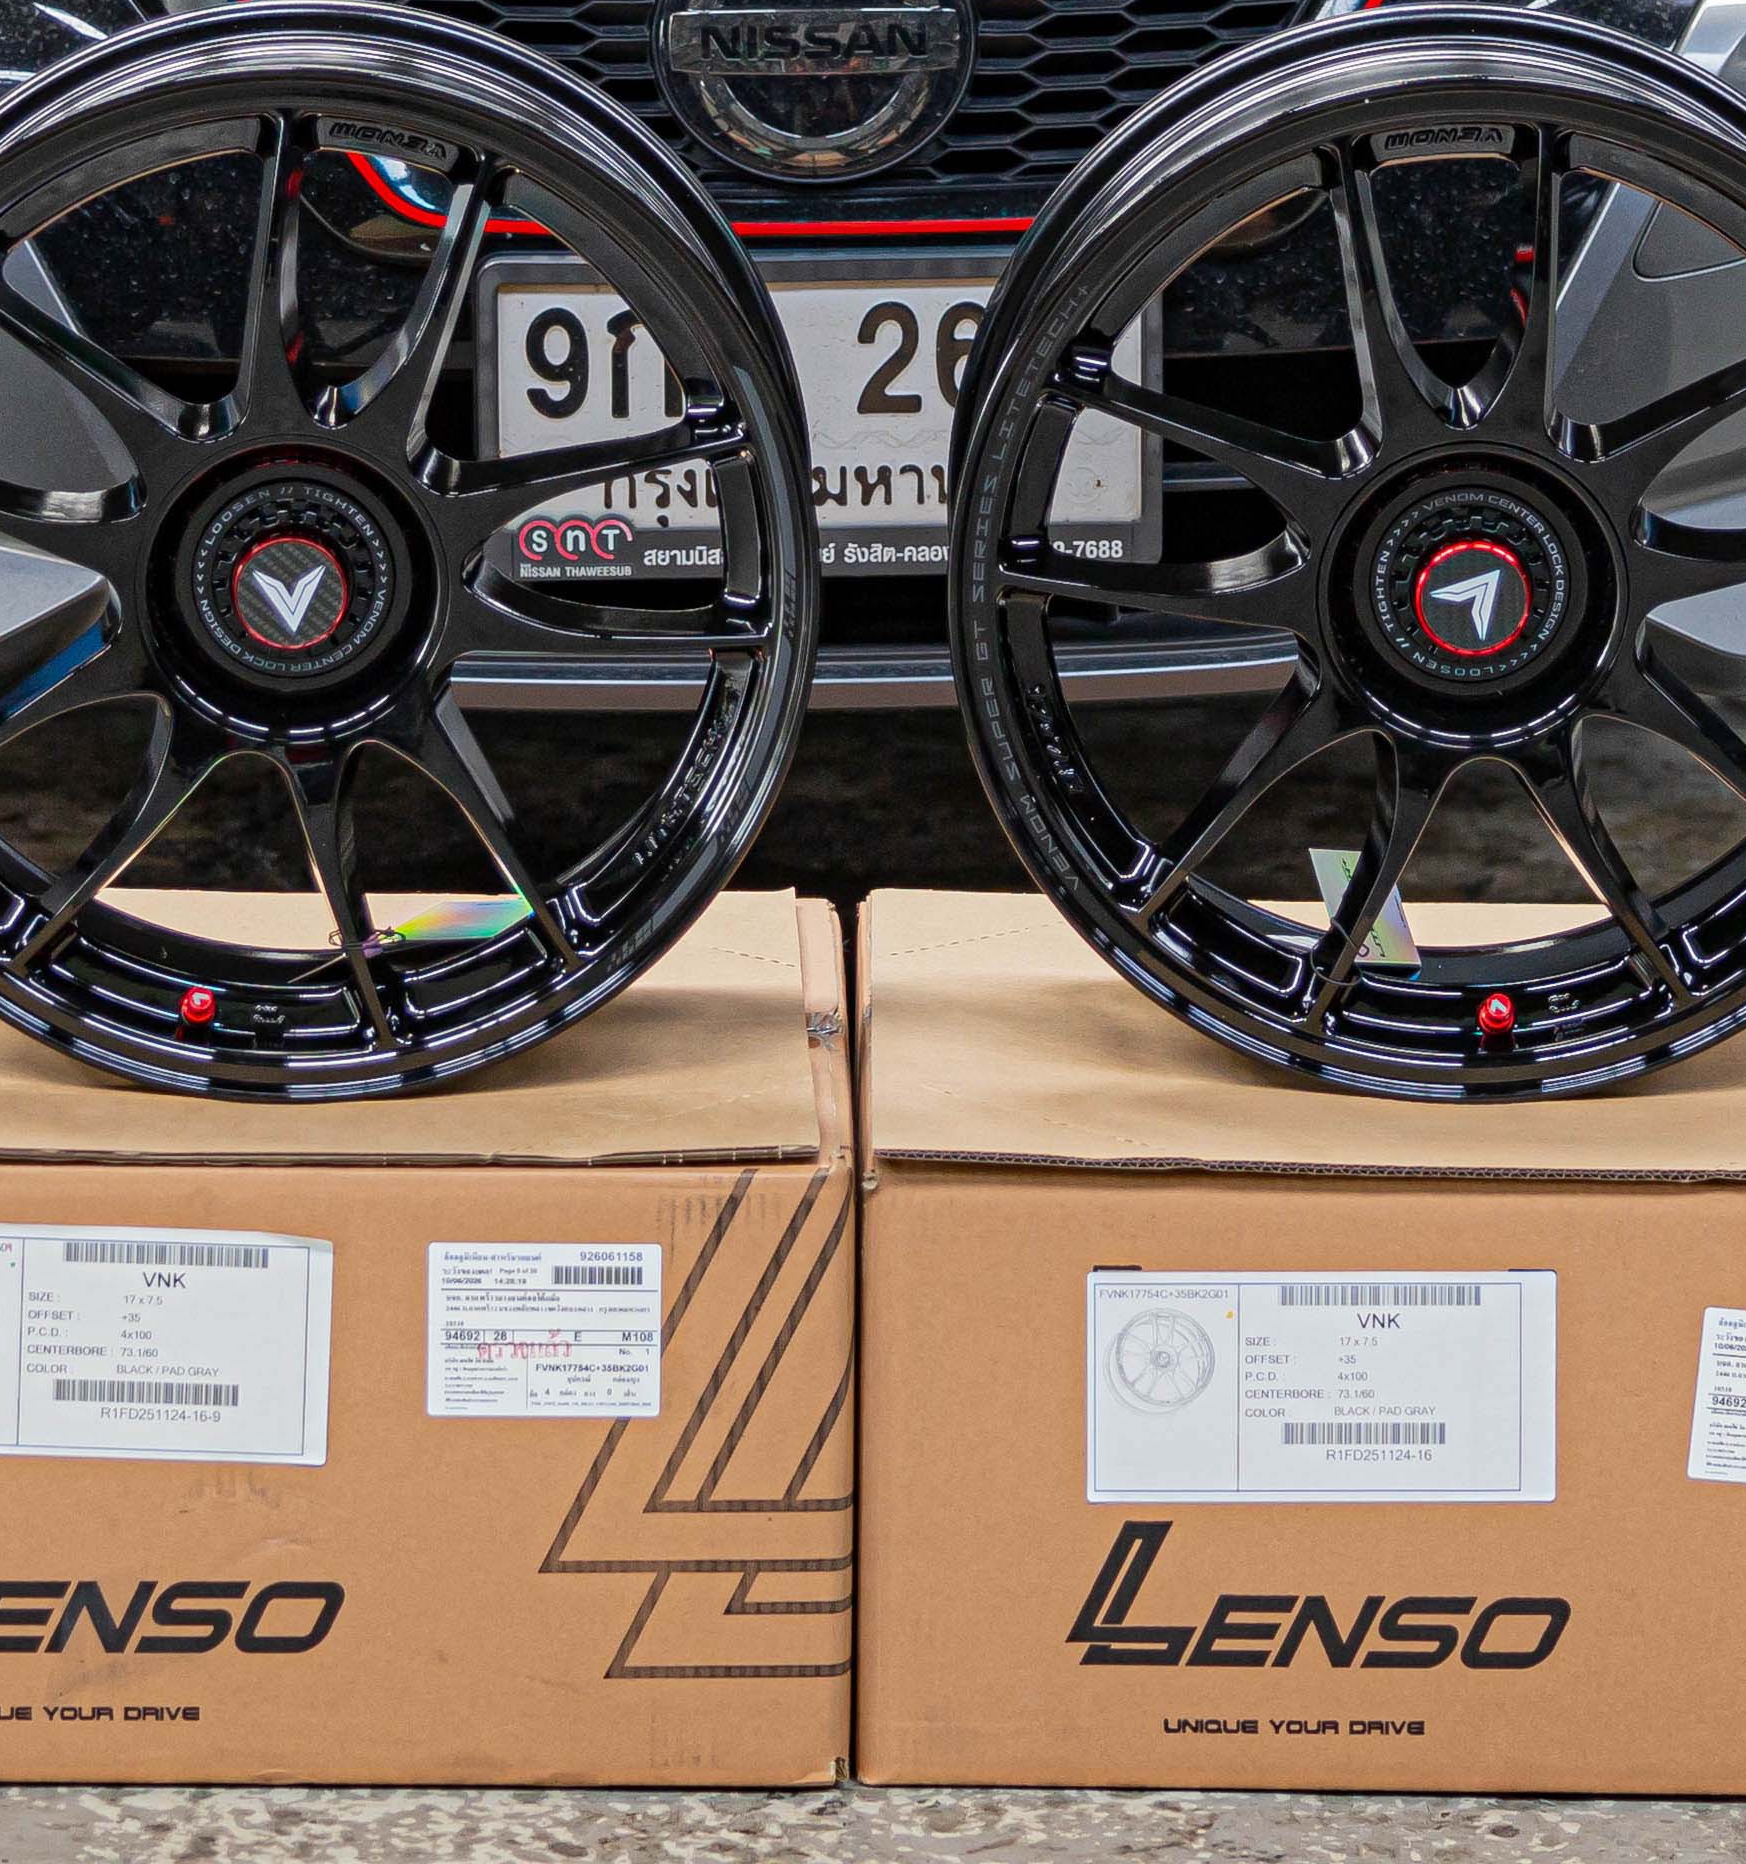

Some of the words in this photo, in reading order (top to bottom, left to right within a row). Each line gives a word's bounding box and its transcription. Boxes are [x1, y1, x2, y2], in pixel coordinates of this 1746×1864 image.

[700, 22, 928, 61] NISSAN
[1384, 128, 1502, 151] VENOM
[1422, 493, 1484, 512] VENOM
[205, 490, 271, 545] LOOSEN
[303, 486, 375, 537] TIGHTEN
[1488, 495, 1544, 533] CENTER
[973, 470, 998, 603] SERIES
[644, 546, 725, 566] สยามนิส
[1543, 533, 1565, 577] LOCK
[520, 567, 561, 578] NISSAN
[565, 566, 632, 577] THAWEESUB
[1375, 551, 1395, 632] TIGHTEN
[354, 590, 386, 644] VENOM
[1539, 579, 1567, 640] DESIGN
[200, 599, 244, 656] DESIGN
[243, 651, 291, 673] LOCK
[293, 645, 354, 673] CENTER
[1413, 651, 1495, 677] LOOSEN
[984, 676, 1020, 782] SUPER
[1020, 795, 1079, 890] VENOM
[579, 1251, 643, 1262] 926061158
[142, 1272, 187, 1289] VNK
[28, 1291, 54, 1302] SIZE
[124, 1295, 136, 1305] 17
[148, 1295, 163, 1305] 7.5
[1099, 1289, 1228, 1299] FVNK17754C+35BK2G01
[28, 1310, 74, 1321] OFFSET
[121, 1313, 141, 1323] +35
[1357, 1313, 1400, 1328] VNK
[121, 1330, 152, 1340] 4x100
[445, 1331, 480, 1341] 94692
[494, 1331, 508, 1341] 28
[574, 1332, 582, 1342] E
[622, 1332, 653, 1342] M108
[1245, 1337, 1270, 1347] SIZE
[1340, 1337, 1351, 1347] 17
[1363, 1337, 1378, 1347] 7.5
[27, 1345, 107, 1356] CENTERBORE
[120, 1347, 158, 1358] 73.1/60
[1245, 1355, 1289, 1365] OFFSET
[1338, 1355, 1356, 1365] +35
[27, 1363, 67, 1374] COLOR
[117, 1364, 154, 1375] BLACK
[161, 1366, 185, 1376] PAD
[188, 1367, 219, 1377] GRAY
[1337, 1372, 1368, 1381] 4x100
[1245, 1389, 1325, 1399] CENTERBORE
[1337, 1389, 1375, 1399] 73.1/60
[1712, 1396, 1746, 1409] 94692
[100, 1407, 222, 1423] R1FD251124-16-9
[1245, 1408, 1286, 1418] COLOR
[1334, 1406, 1370, 1416] BLACK
[1379, 1406, 1402, 1416] PAD
[1404, 1406, 1436, 1416] GRAY
[1326, 1449, 1432, 1462] R1FD251124-16
[1065, 1520, 1571, 1670] LENSO
[43, 1706, 114, 1721] YOUR
[124, 1706, 200, 1721] DRIVE
[1163, 1719, 1259, 1734] UNIQUE
[1269, 1719, 1339, 1735] YOUR
[1349, 1720, 1425, 1736] DRIVE
